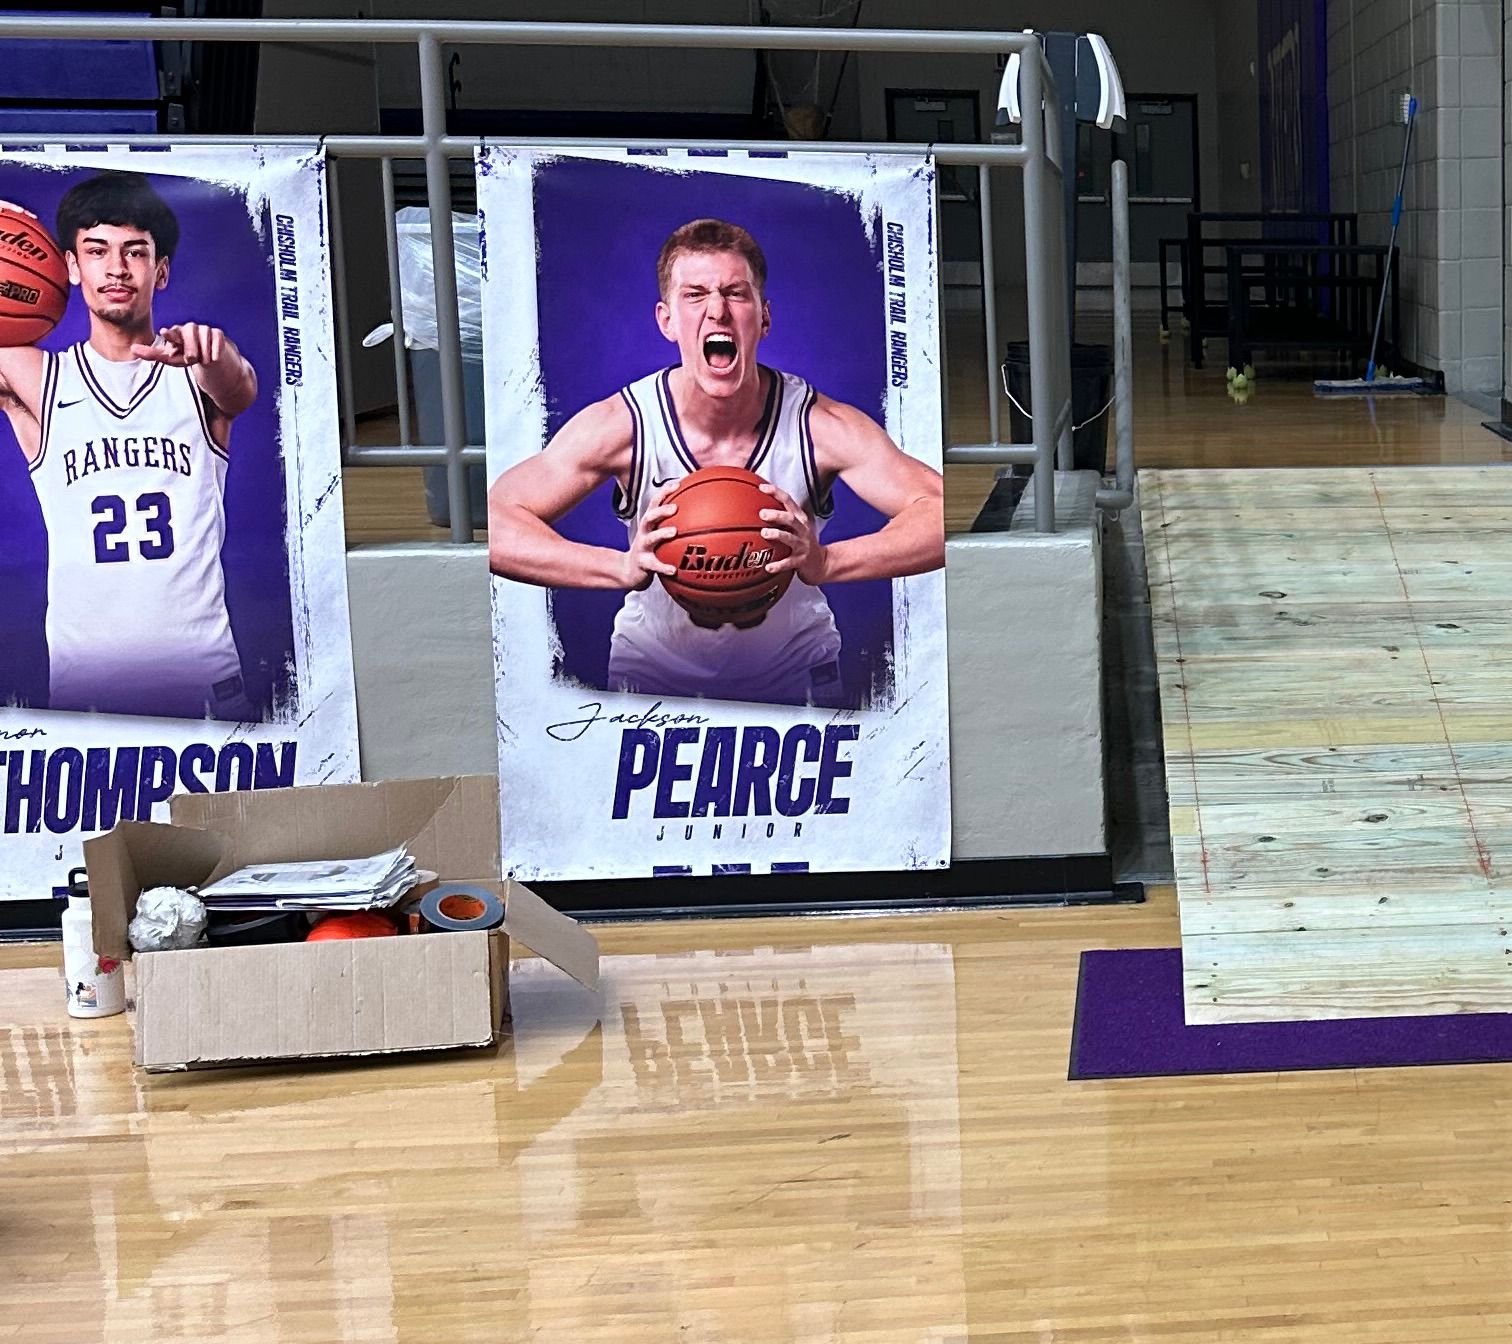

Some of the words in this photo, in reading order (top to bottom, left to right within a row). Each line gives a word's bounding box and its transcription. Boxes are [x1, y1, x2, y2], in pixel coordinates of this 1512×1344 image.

[275, 213, 298, 283] CHISHOLM
[887, 221, 906, 289] CHISHOLM
[281, 286, 300, 321] TRAIL
[889, 291, 907, 325] TRAIL
[283, 326, 303, 386] RANGERS
[890, 330, 908, 388] RANGERS
[63, 436, 192, 487] RANGERS
[91, 491, 175, 564] 23
[679, 541, 775, 572] Baden
[546, 701, 710, 741] Jackson
[0, 741, 298, 834] HOMPSON
[612, 723, 861, 820] PEARCE
[656, 822, 803, 842] JUNIOR
